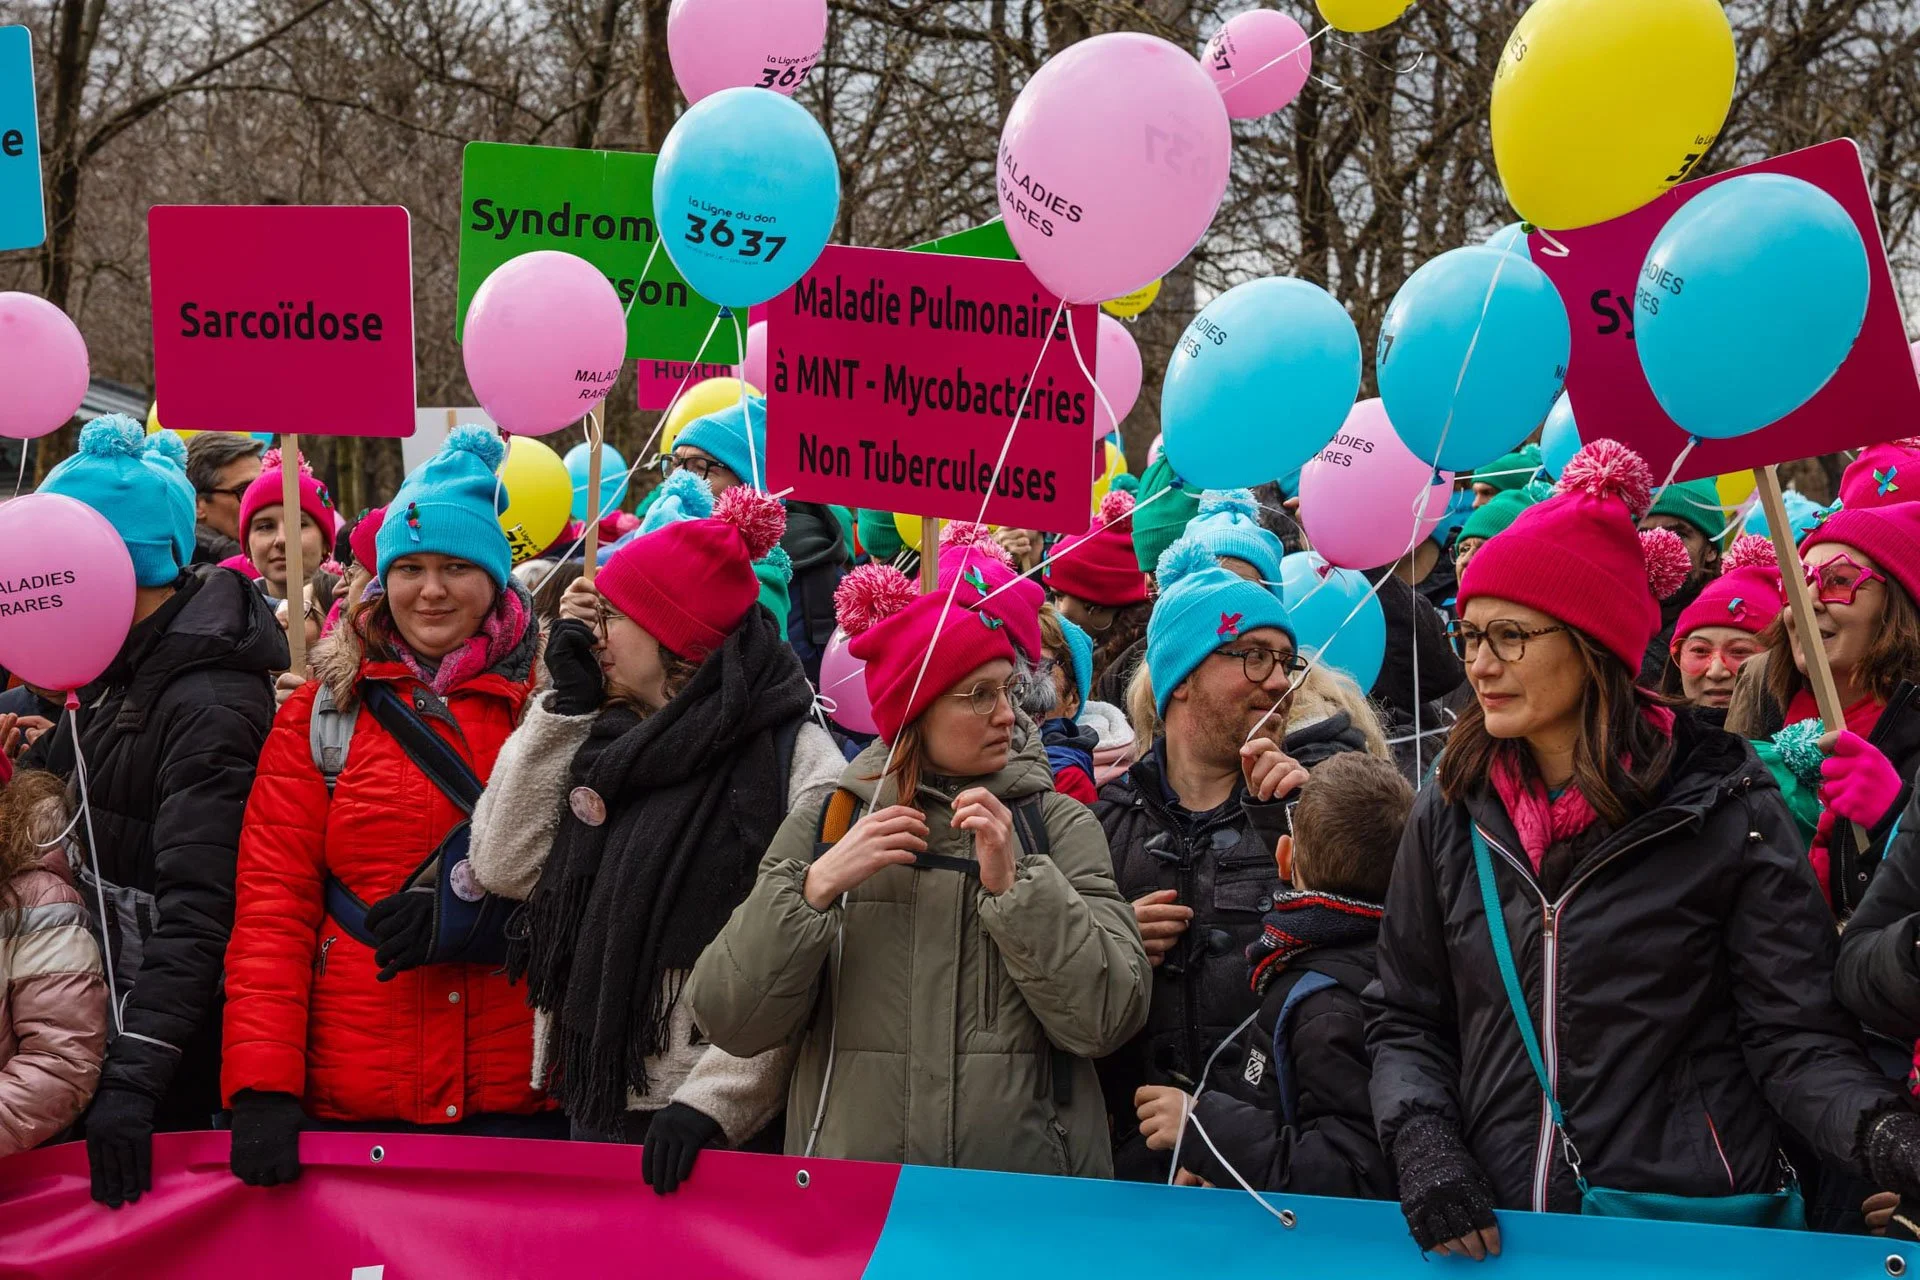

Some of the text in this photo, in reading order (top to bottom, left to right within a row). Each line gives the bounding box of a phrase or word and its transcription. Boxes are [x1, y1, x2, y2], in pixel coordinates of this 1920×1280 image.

[778, 56, 800, 67] Ligne
[2, 129, 24, 157] e
[1001, 139, 1083, 223] MALADIES
[688, 195, 777, 224] la Ligne du don
[1000, 177, 1054, 238] RARES
[684, 212, 788, 263] 3637
[180, 300, 383, 342] Sarcoïdose
[793, 274, 1069, 342] Maladie Pulmonaire
[773, 347, 1086, 426] à MNT - Mycobactéries
[798, 432, 1057, 503] Non Tuberculeuses
[0, 594, 63, 617] RARES
